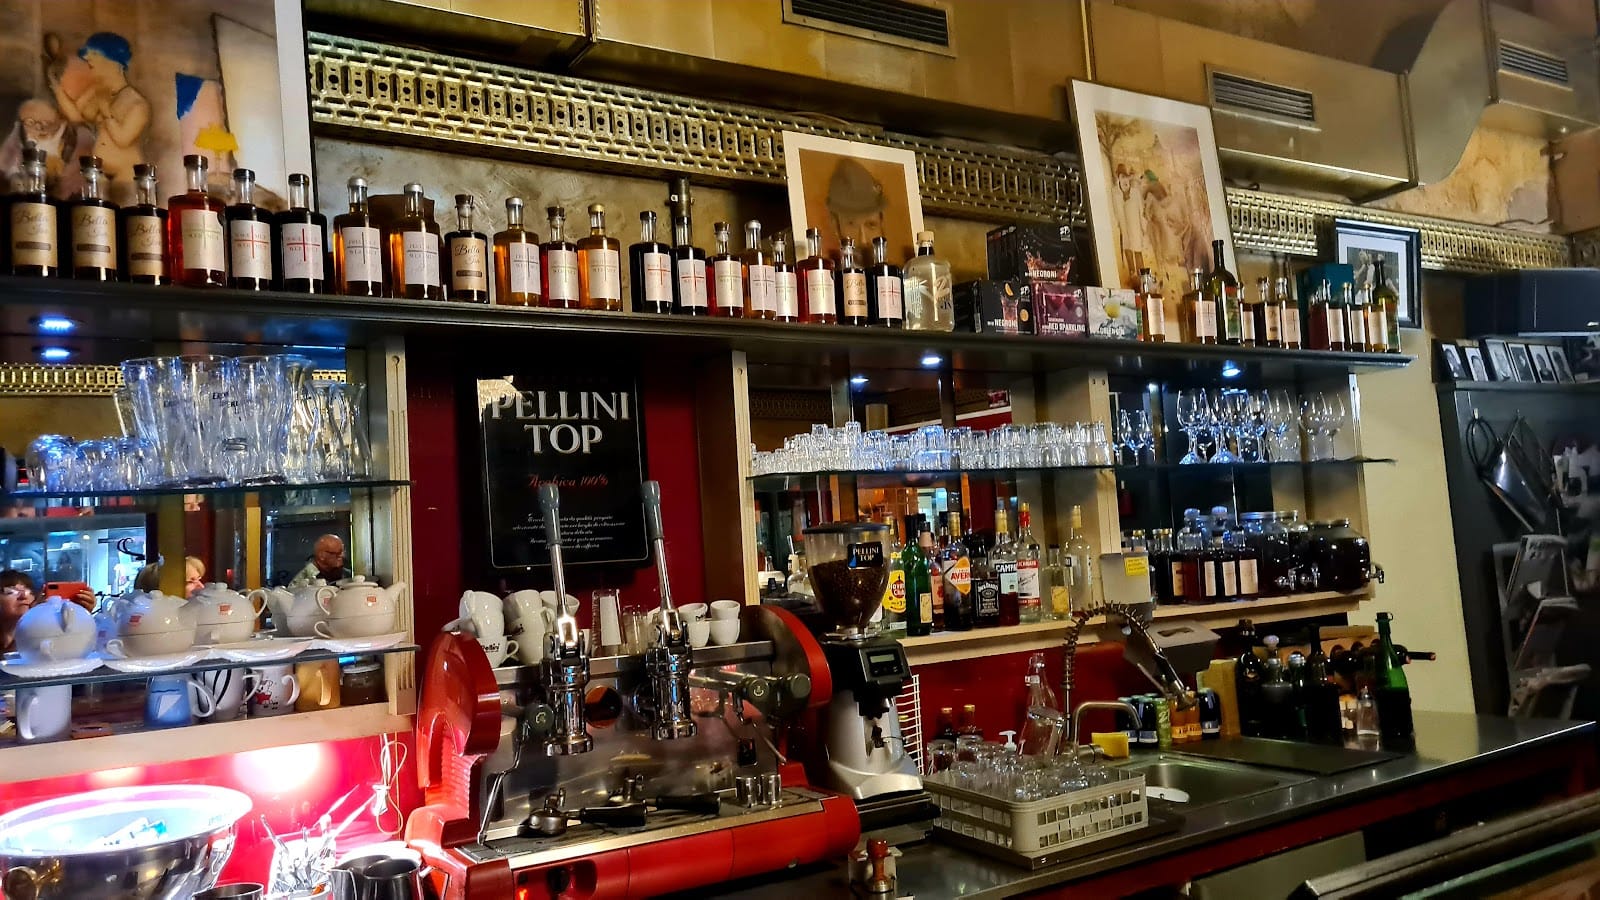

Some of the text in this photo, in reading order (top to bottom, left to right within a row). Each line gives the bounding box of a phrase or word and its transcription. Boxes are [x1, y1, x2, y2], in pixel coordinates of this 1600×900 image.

[1059, 323, 1086, 333] SPARKLING
[491, 390, 631, 421] PELLINI
[524, 424, 603, 454] TOP
[854, 546, 879, 556] PELLINI
